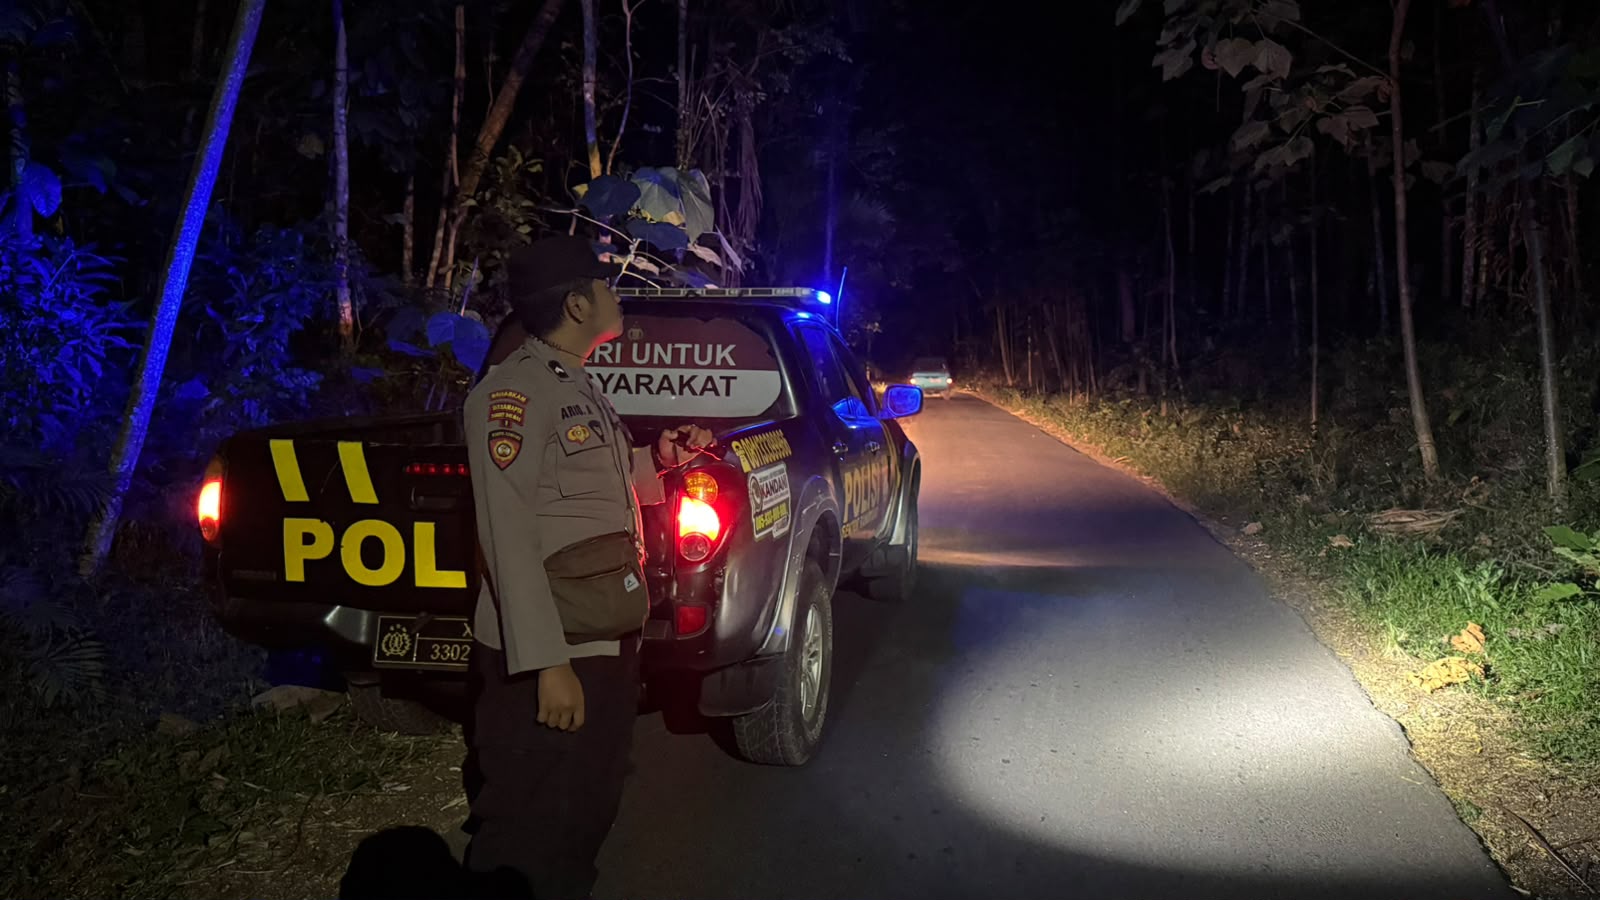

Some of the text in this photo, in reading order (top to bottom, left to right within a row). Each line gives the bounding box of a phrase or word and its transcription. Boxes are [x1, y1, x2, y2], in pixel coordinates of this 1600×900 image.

[587, 342, 737, 367] RI UNTUK
[588, 373, 737, 397] YARAKAT
[283, 517, 467, 588] POL
[430, 643, 472, 661] 3302
